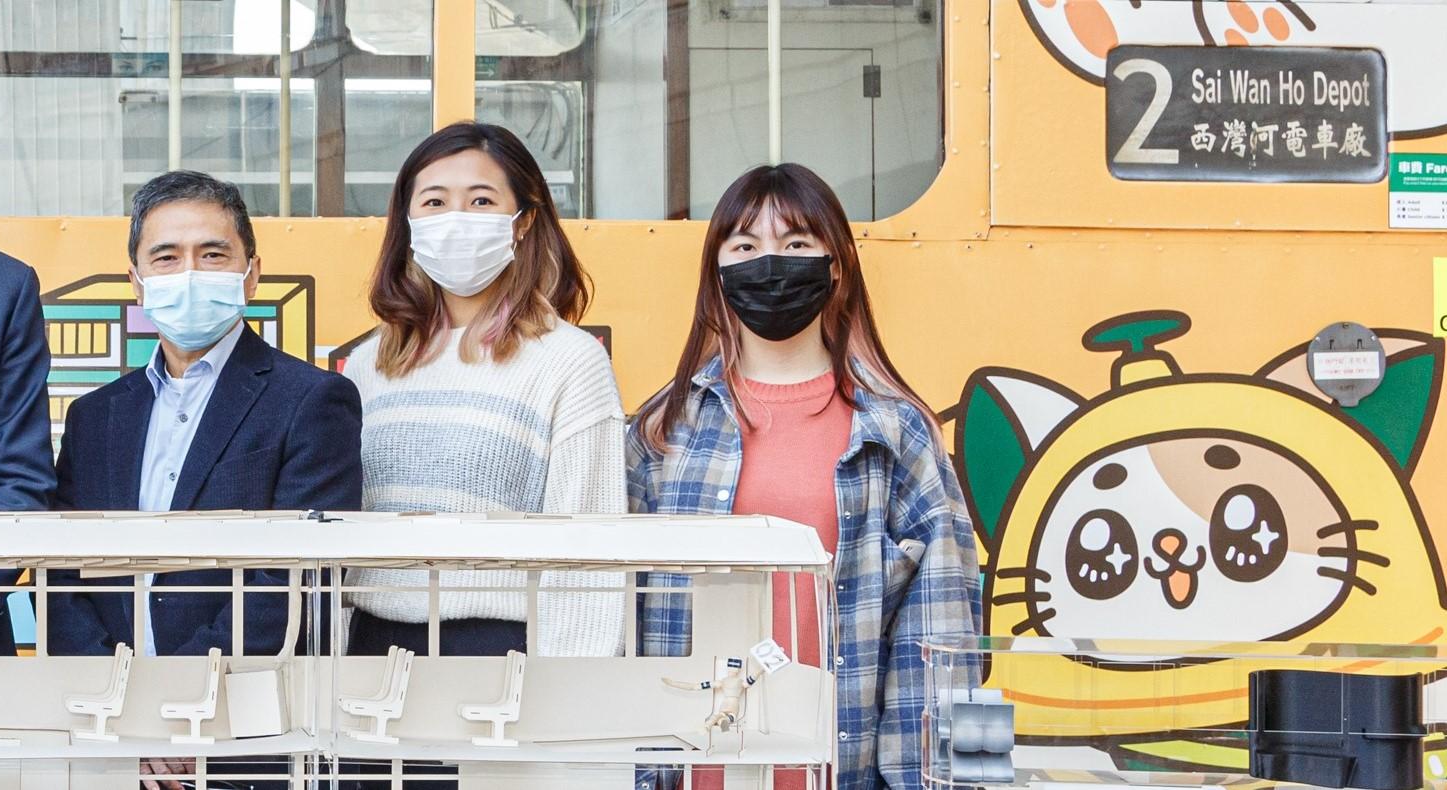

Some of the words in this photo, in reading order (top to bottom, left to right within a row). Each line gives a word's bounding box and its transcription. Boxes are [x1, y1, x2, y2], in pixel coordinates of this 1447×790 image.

[1113, 58, 1179, 164] 2
[1191, 68, 1222, 104] Sai
[1229, 69, 1270, 105] Wan
[1279, 71, 1305, 106] Ho
[1313, 71, 1370, 112] Depot
[1190, 118, 1372, 160] 西灣河電車廠
